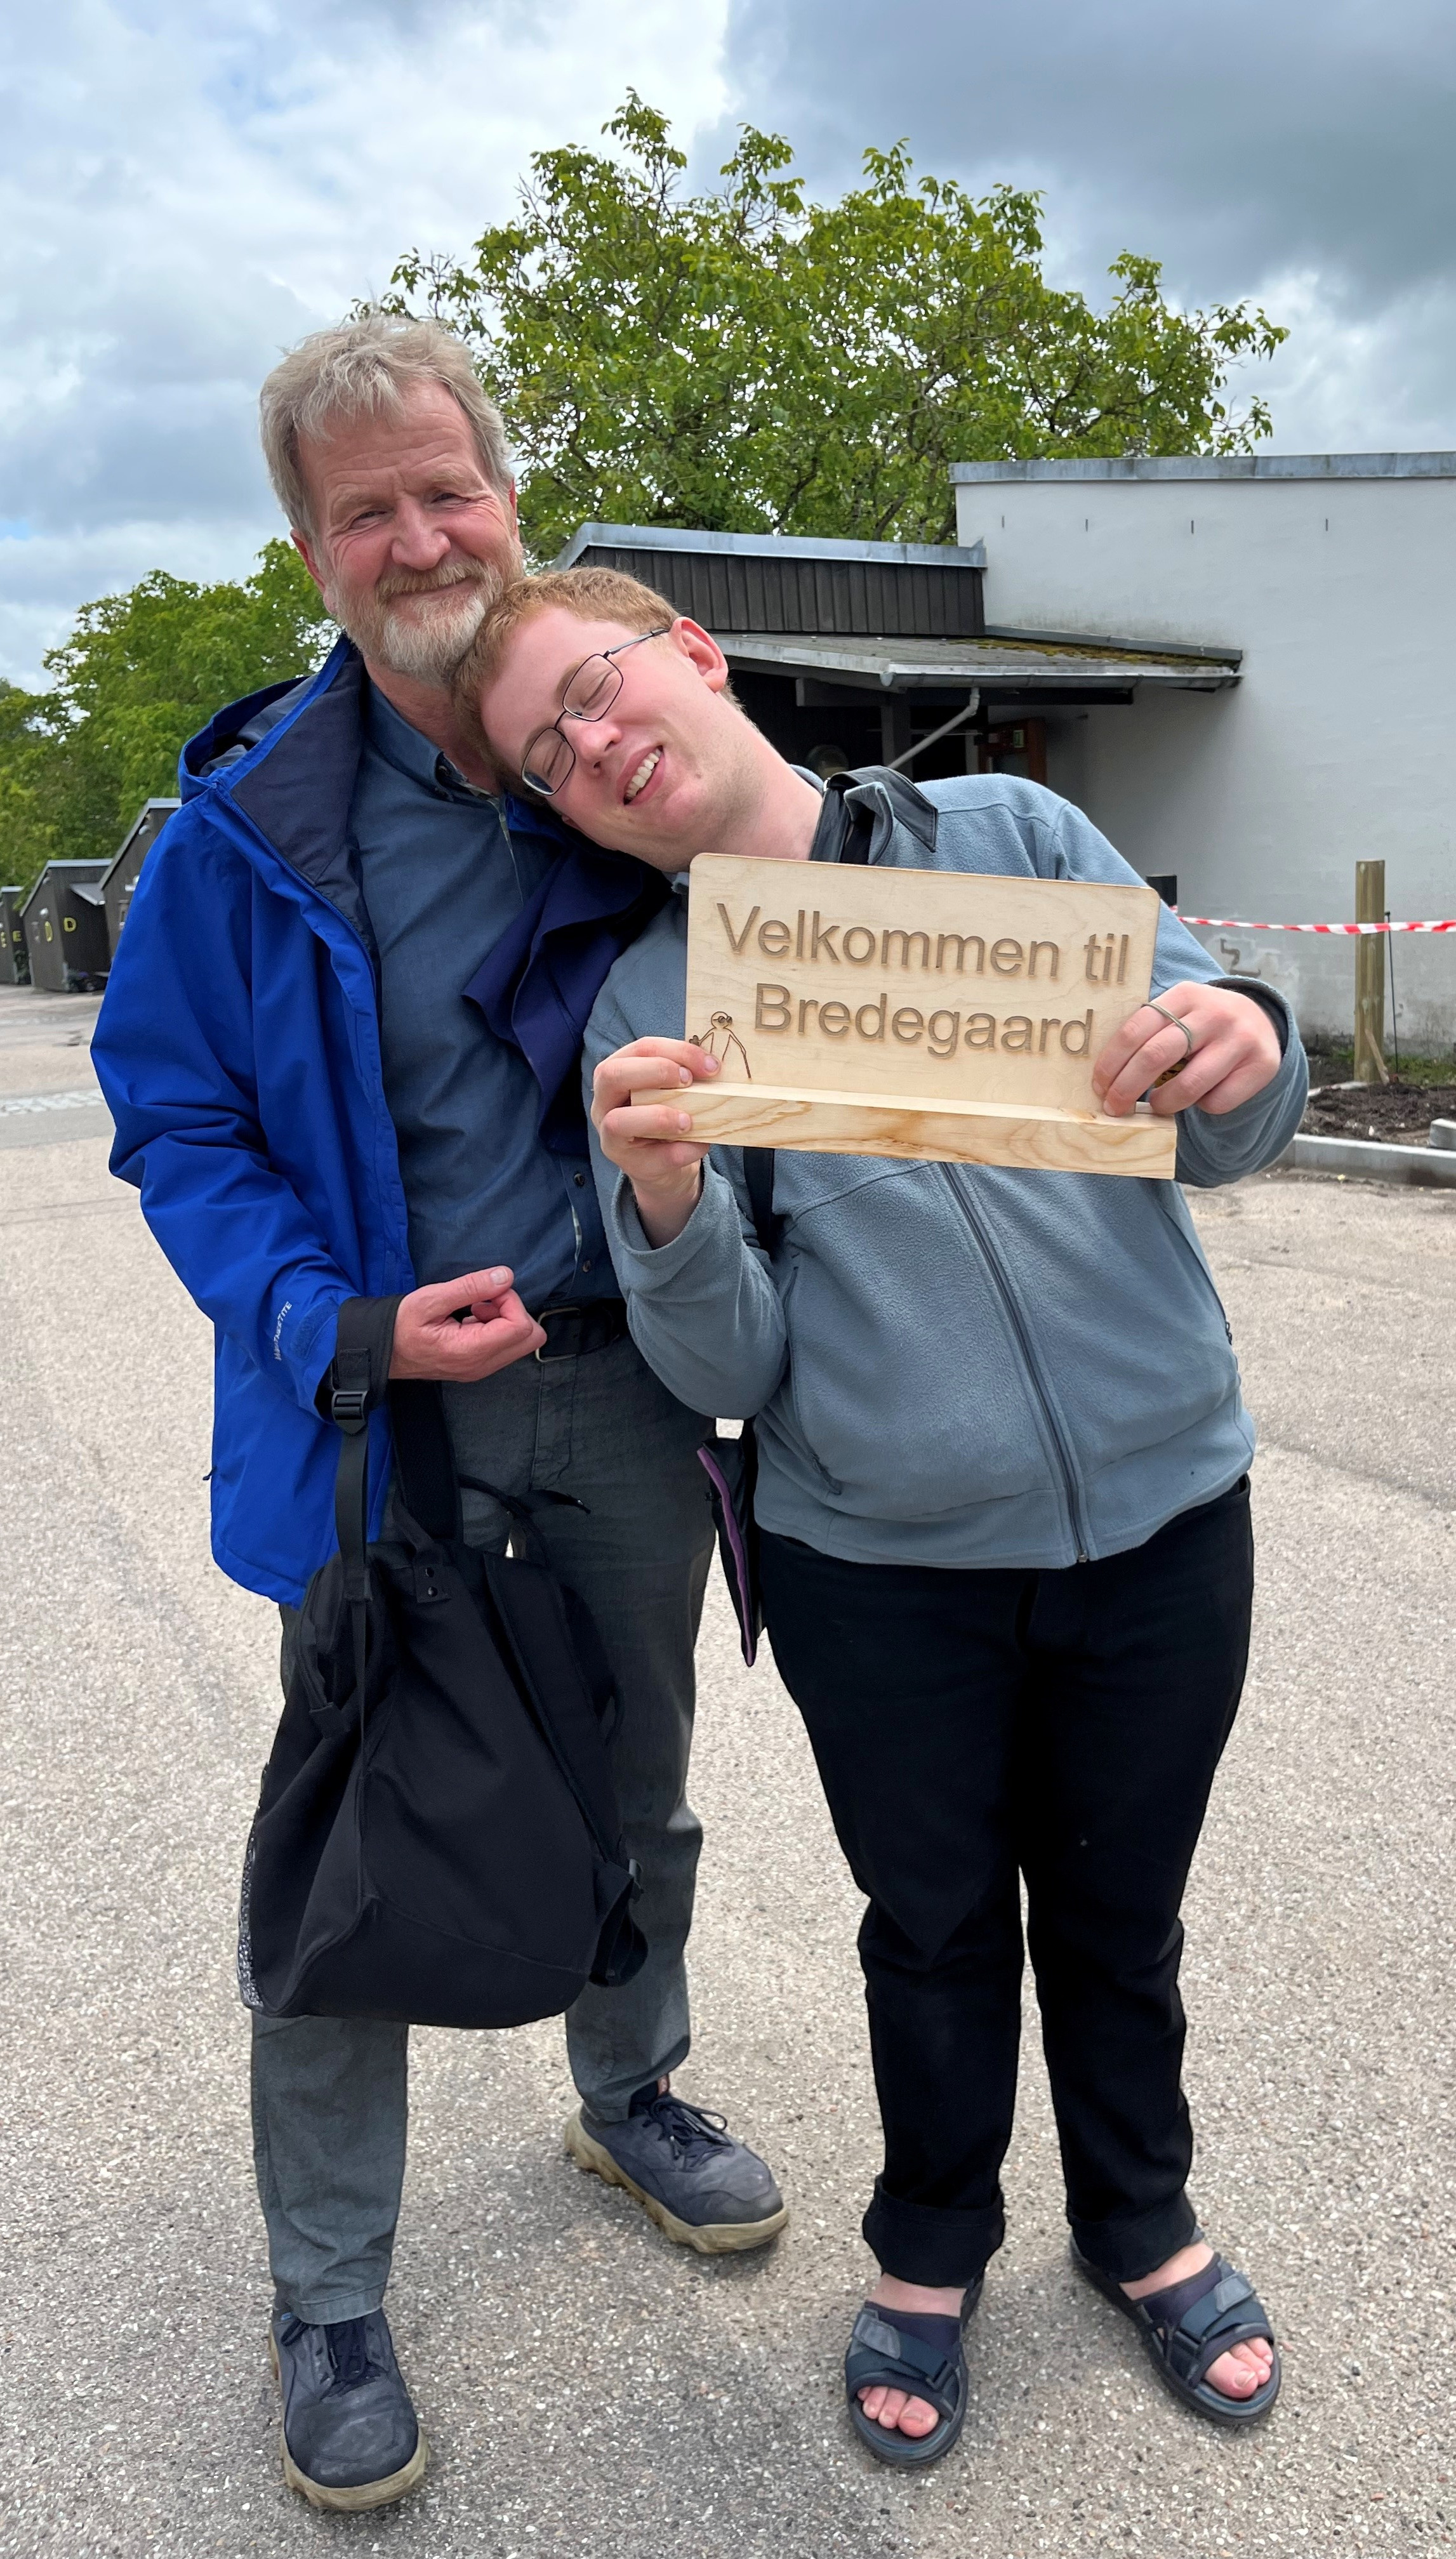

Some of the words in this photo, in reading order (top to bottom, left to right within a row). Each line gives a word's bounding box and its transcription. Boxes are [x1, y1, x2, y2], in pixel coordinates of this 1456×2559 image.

[63, 917, 76, 932] D
[717, 903, 1060, 979] Velkommen
[1083, 932, 1130, 983] til
[755, 982, 1094, 1059] Bredegaard
